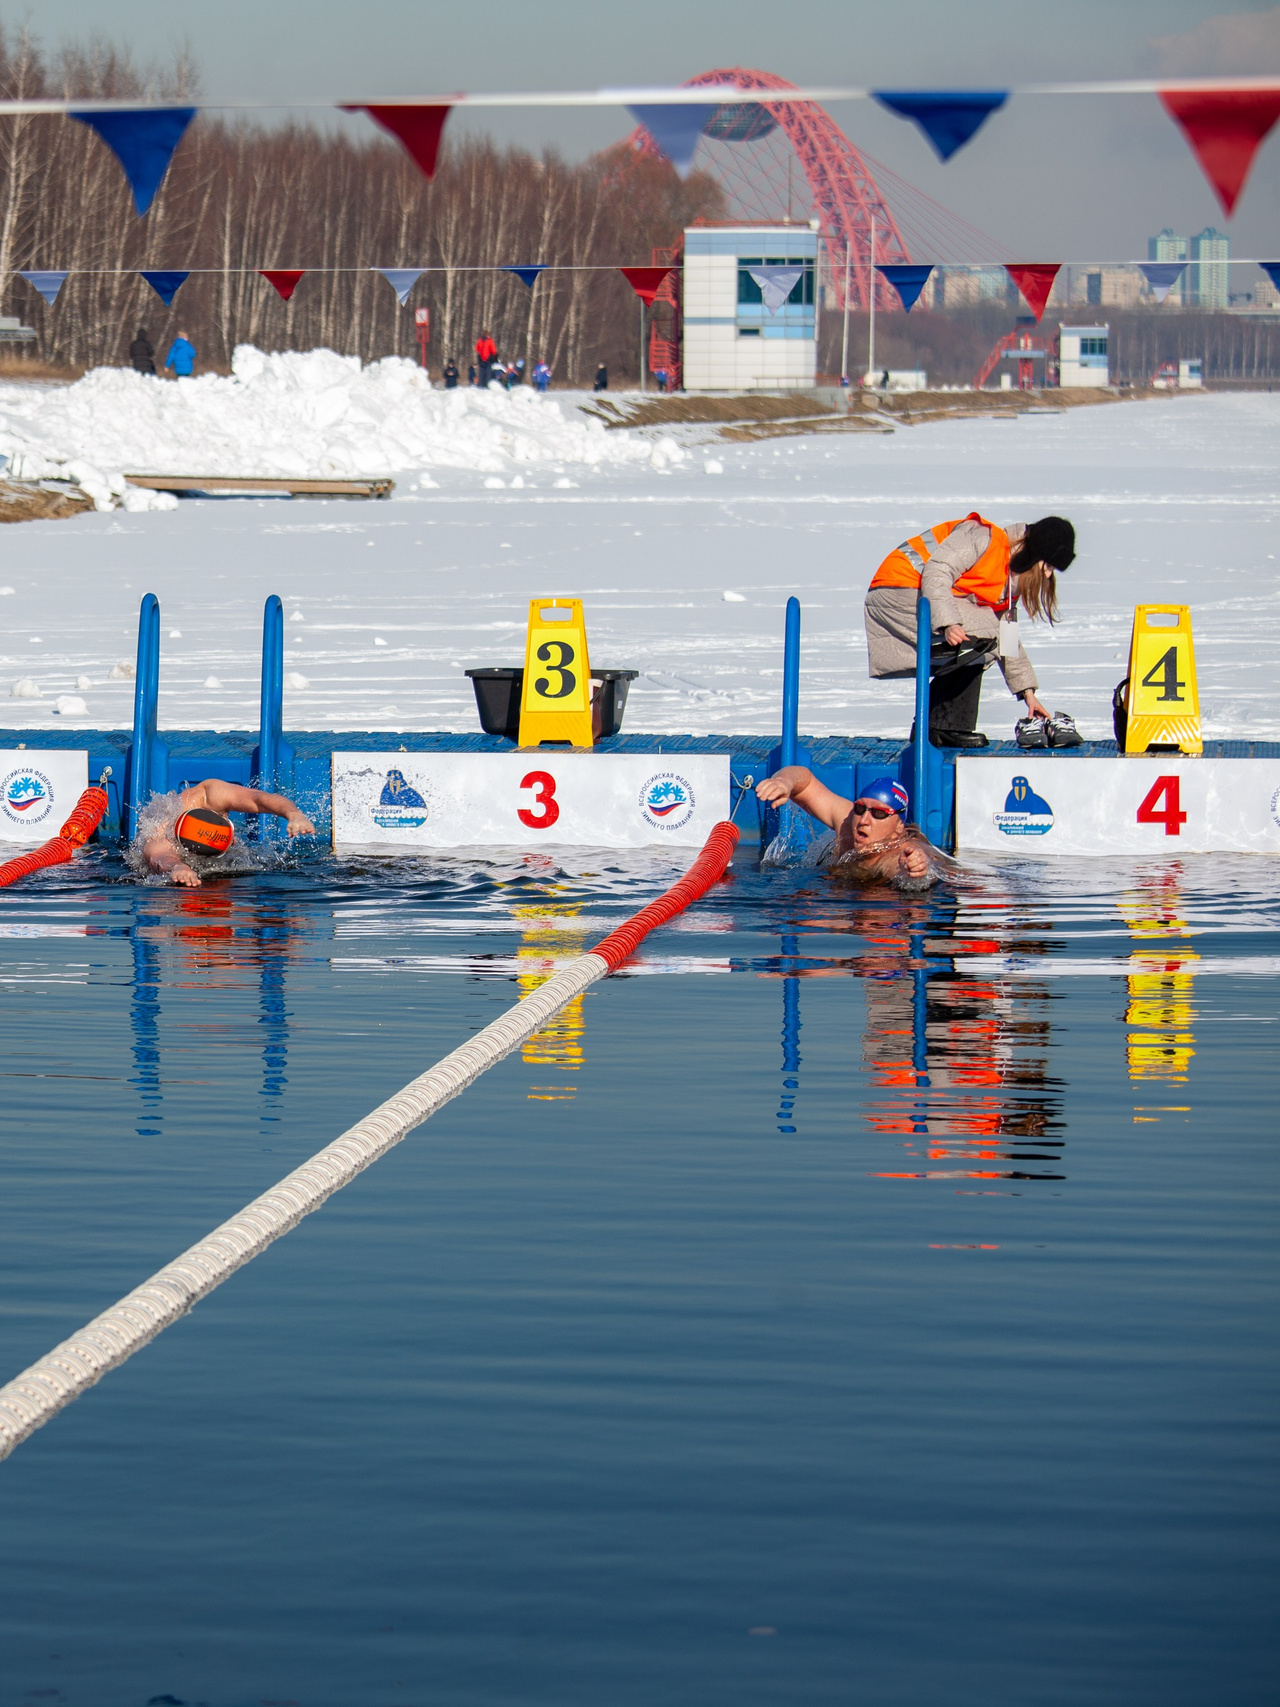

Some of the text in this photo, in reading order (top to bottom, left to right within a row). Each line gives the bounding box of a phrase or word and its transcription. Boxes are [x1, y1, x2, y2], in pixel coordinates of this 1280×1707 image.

[534, 641, 576, 699] 3
[1142, 646, 1186, 702] 4
[0, 768, 54, 802] ВСЕРОССИЙСКАЯ ФЕДЕРАЦИЯ
[517, 770, 560, 830] 3
[638, 772, 696, 808] ВСЕРОССИЙСКАЯ ФЕДЕРАЦИЯ
[1136, 775, 1188, 836] 4
[1, 804, 52, 825] ЗИМНЕГО ПЛАВАНИЯ
[640, 809, 693, 831] ЗИМНЕГО ПЛАВАНИЯ
